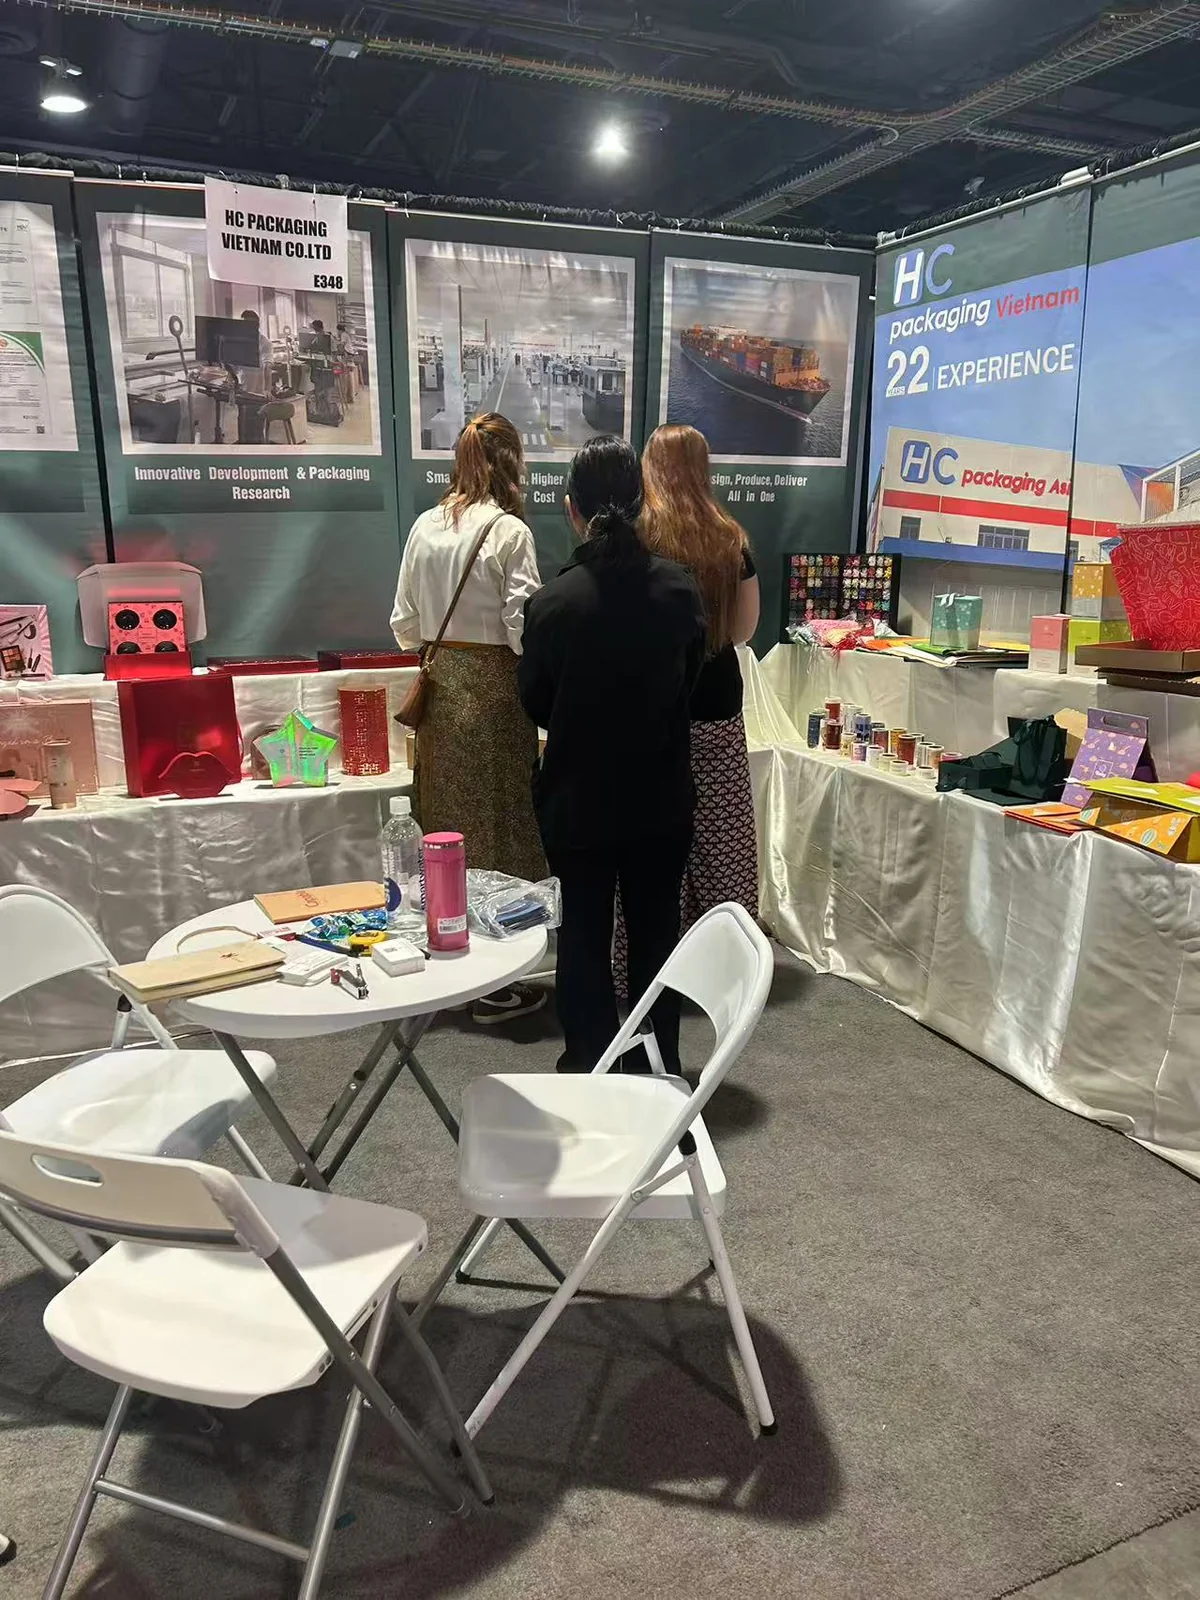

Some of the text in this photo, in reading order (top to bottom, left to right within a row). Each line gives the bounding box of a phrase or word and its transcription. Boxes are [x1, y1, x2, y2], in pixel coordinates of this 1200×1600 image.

[225, 209, 327, 238] HC PACKAGING
[221, 232, 332, 260] VIETNAM CO.LTD
[313, 275, 343, 289] E348
[893, 244, 955, 306] HC
[889, 286, 1080, 345] packaging Vietnam
[886, 343, 1075, 397] 22 EXPERIENCE
[134, 466, 370, 481] Innovative Development & Packaging
[900, 439, 959, 485] HC
[961, 468, 1047, 497] packaging
[426, 470, 451, 484] Sma
[531, 472, 564, 487] Higher
[710, 474, 808, 487] sign, Produce, Deliver
[232, 486, 290, 500] Research
[533, 491, 555, 503] Cost
[727, 490, 775, 502] All in One
